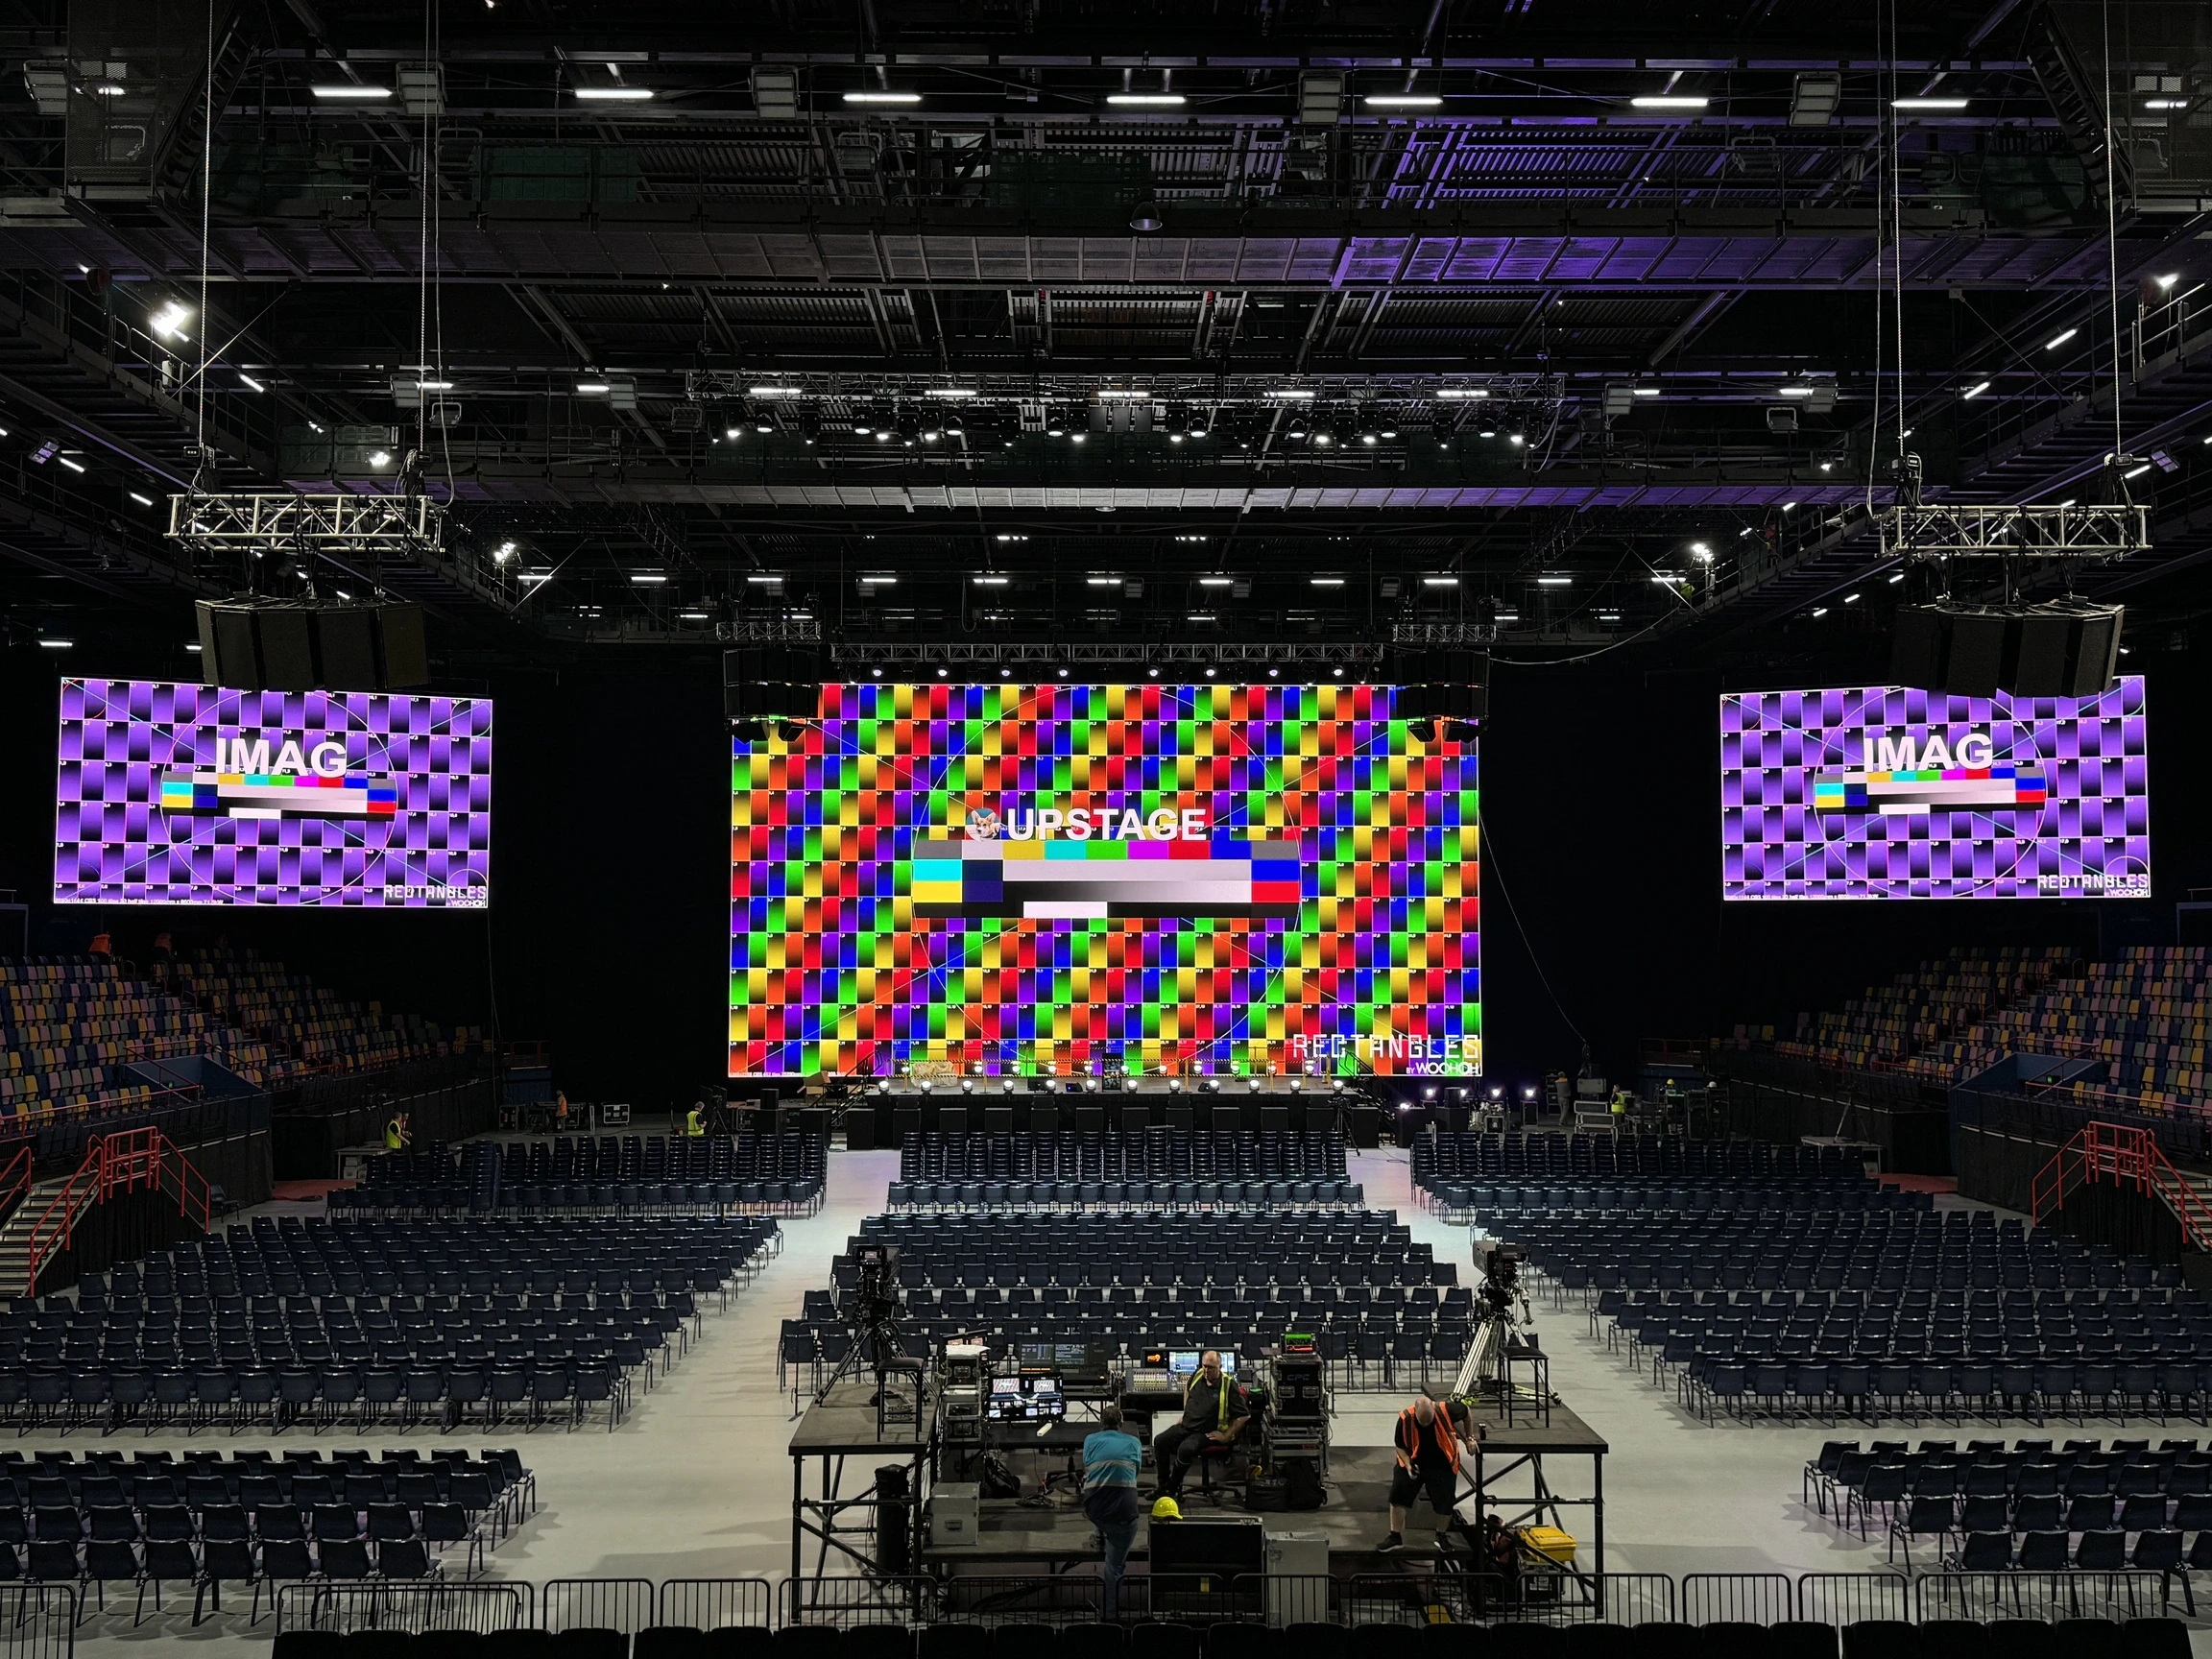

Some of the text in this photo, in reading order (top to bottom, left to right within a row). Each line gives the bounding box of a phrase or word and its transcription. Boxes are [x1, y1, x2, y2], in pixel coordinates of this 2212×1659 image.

[216, 737, 348, 778] IMAG
[1863, 733, 1993, 772] IMAG
[1007, 807, 1208, 841] UPSTAGE
[1292, 1033, 1480, 1059] RECTANGLES
[1416, 1062, 1479, 1074] WOOHOH
